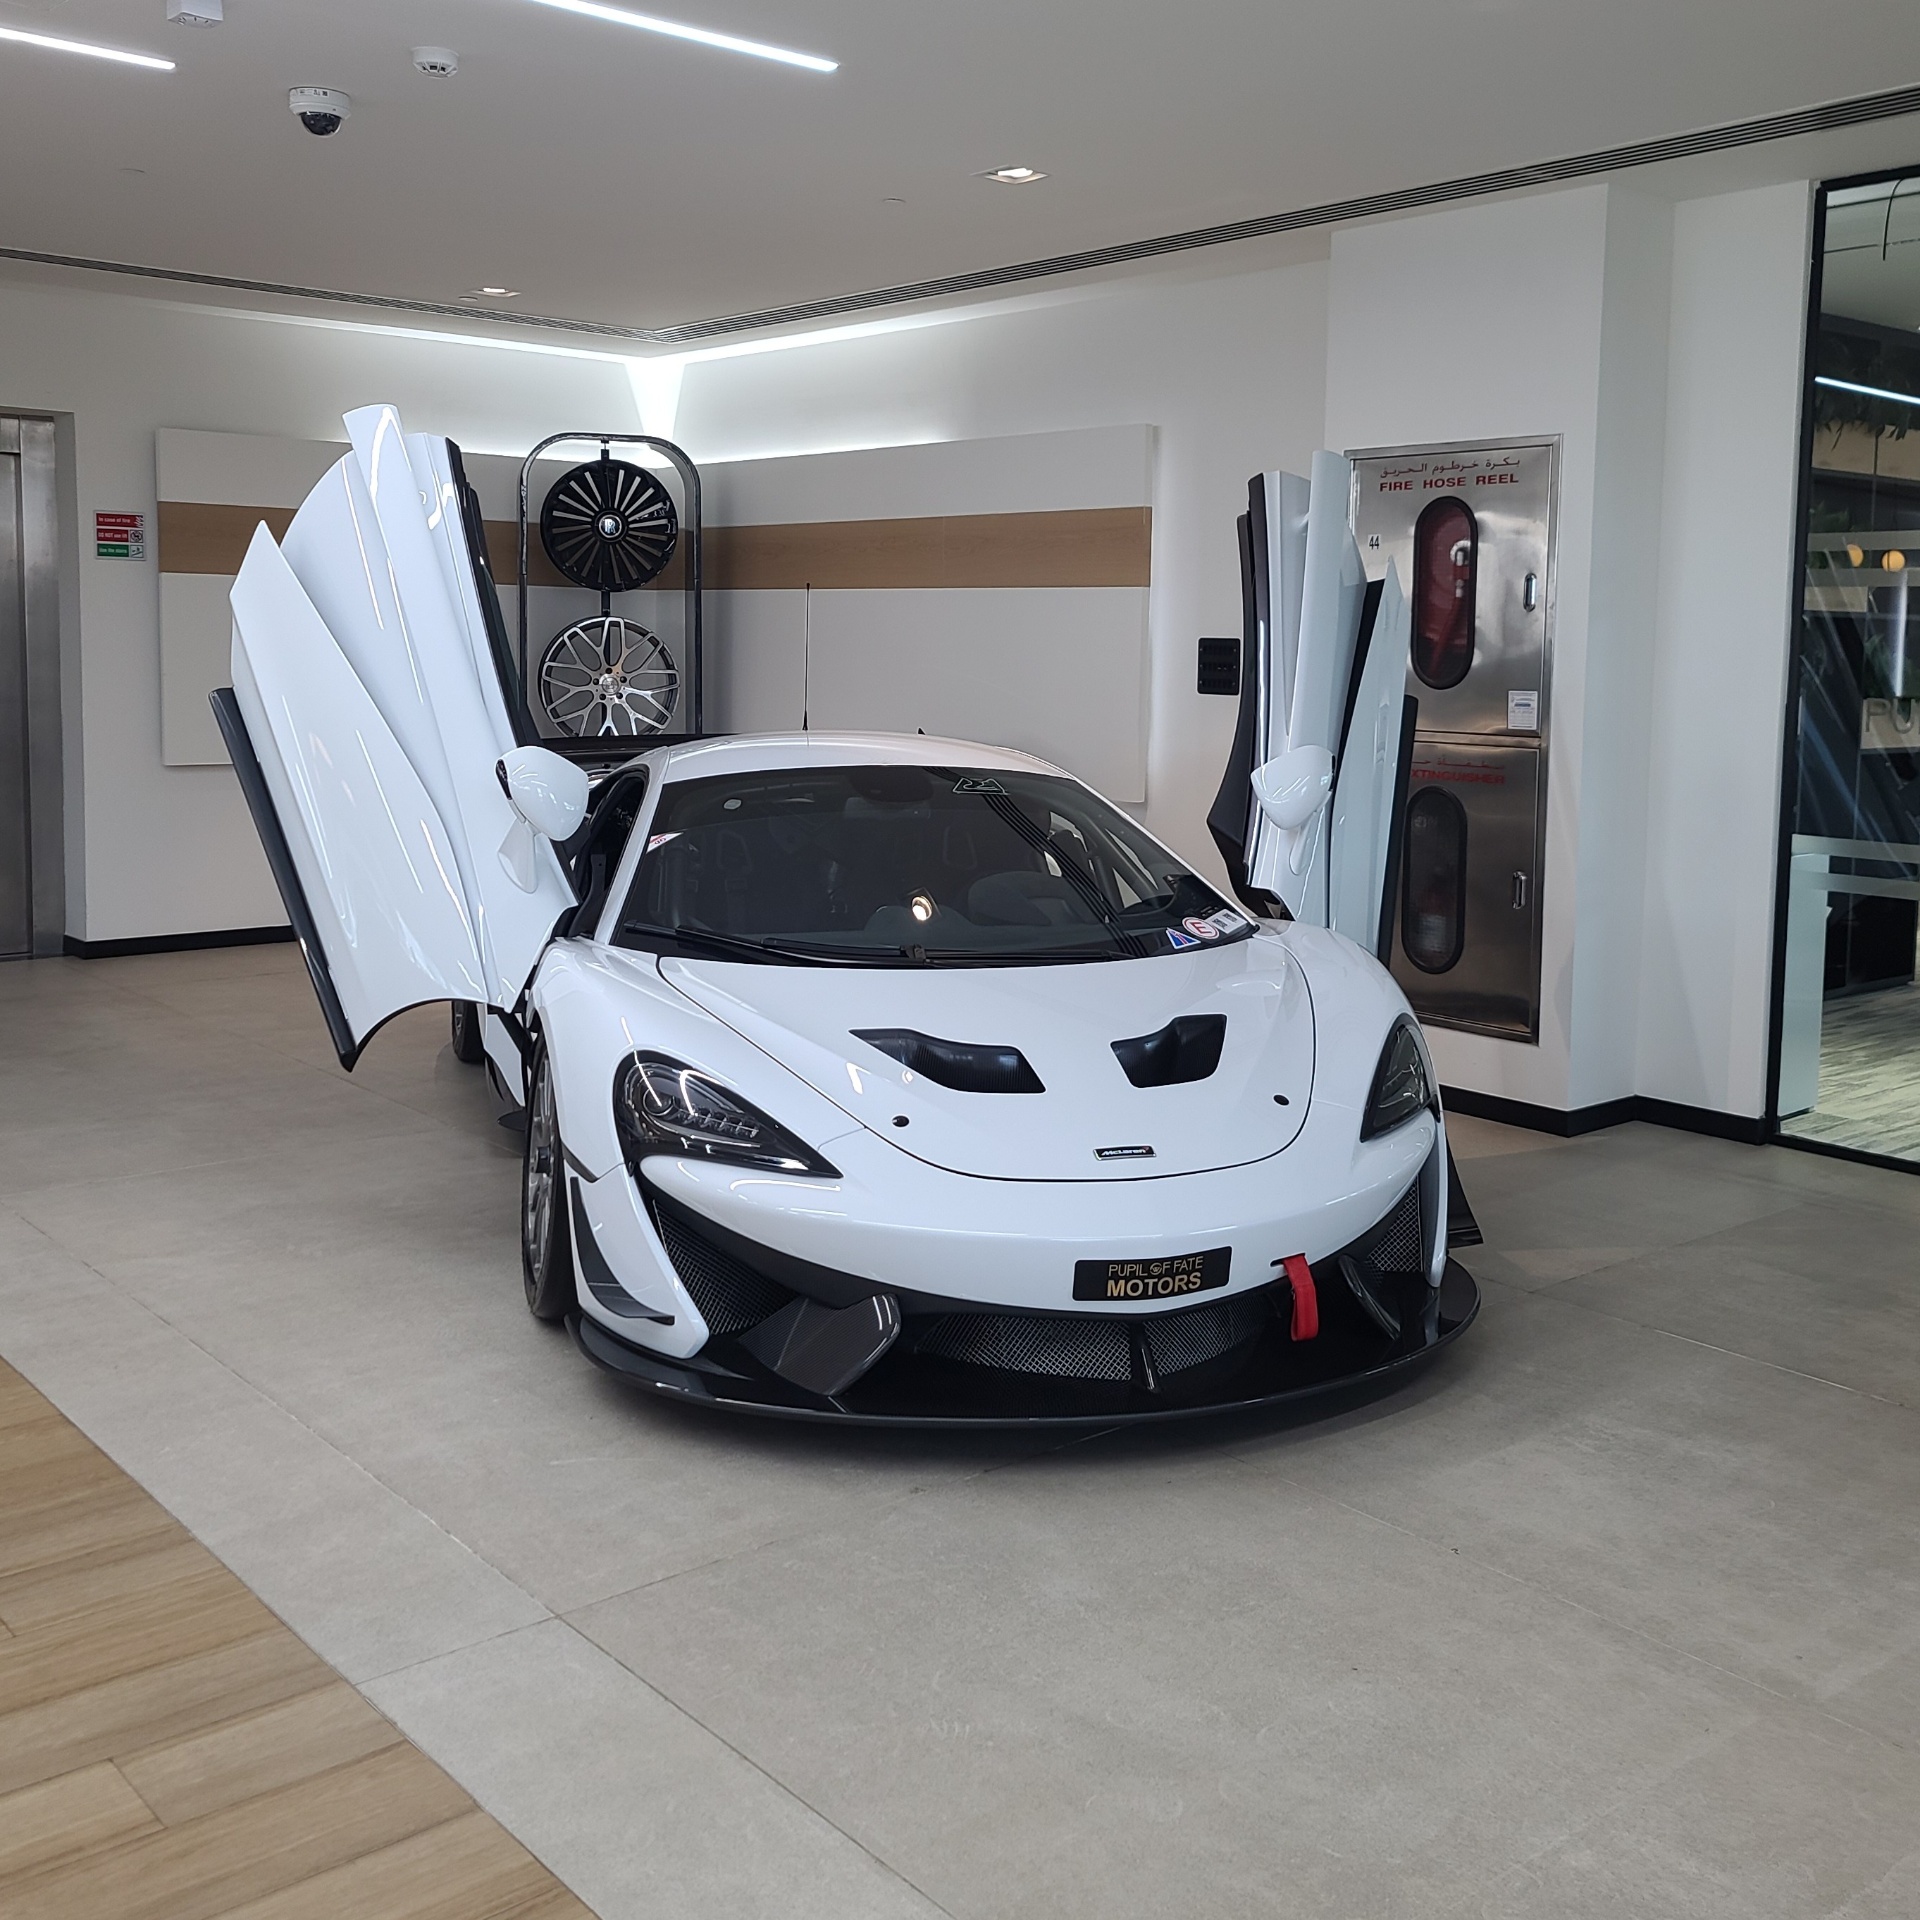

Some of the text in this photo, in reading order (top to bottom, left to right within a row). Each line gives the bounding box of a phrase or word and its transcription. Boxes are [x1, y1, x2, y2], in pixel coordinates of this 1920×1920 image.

[1380, 457, 1520, 478] بكرة خرطوم الحريق
[1380, 473, 1519, 492] FIRE HOSE REEL
[1369, 535, 1379, 550] 44
[1864, 697, 1920, 734] PU
[1411, 769, 1505, 784] XTINGUISHER
[1109, 1256, 1204, 1277] PUPIL OF FATE
[1106, 1272, 1201, 1297] MOTORS
